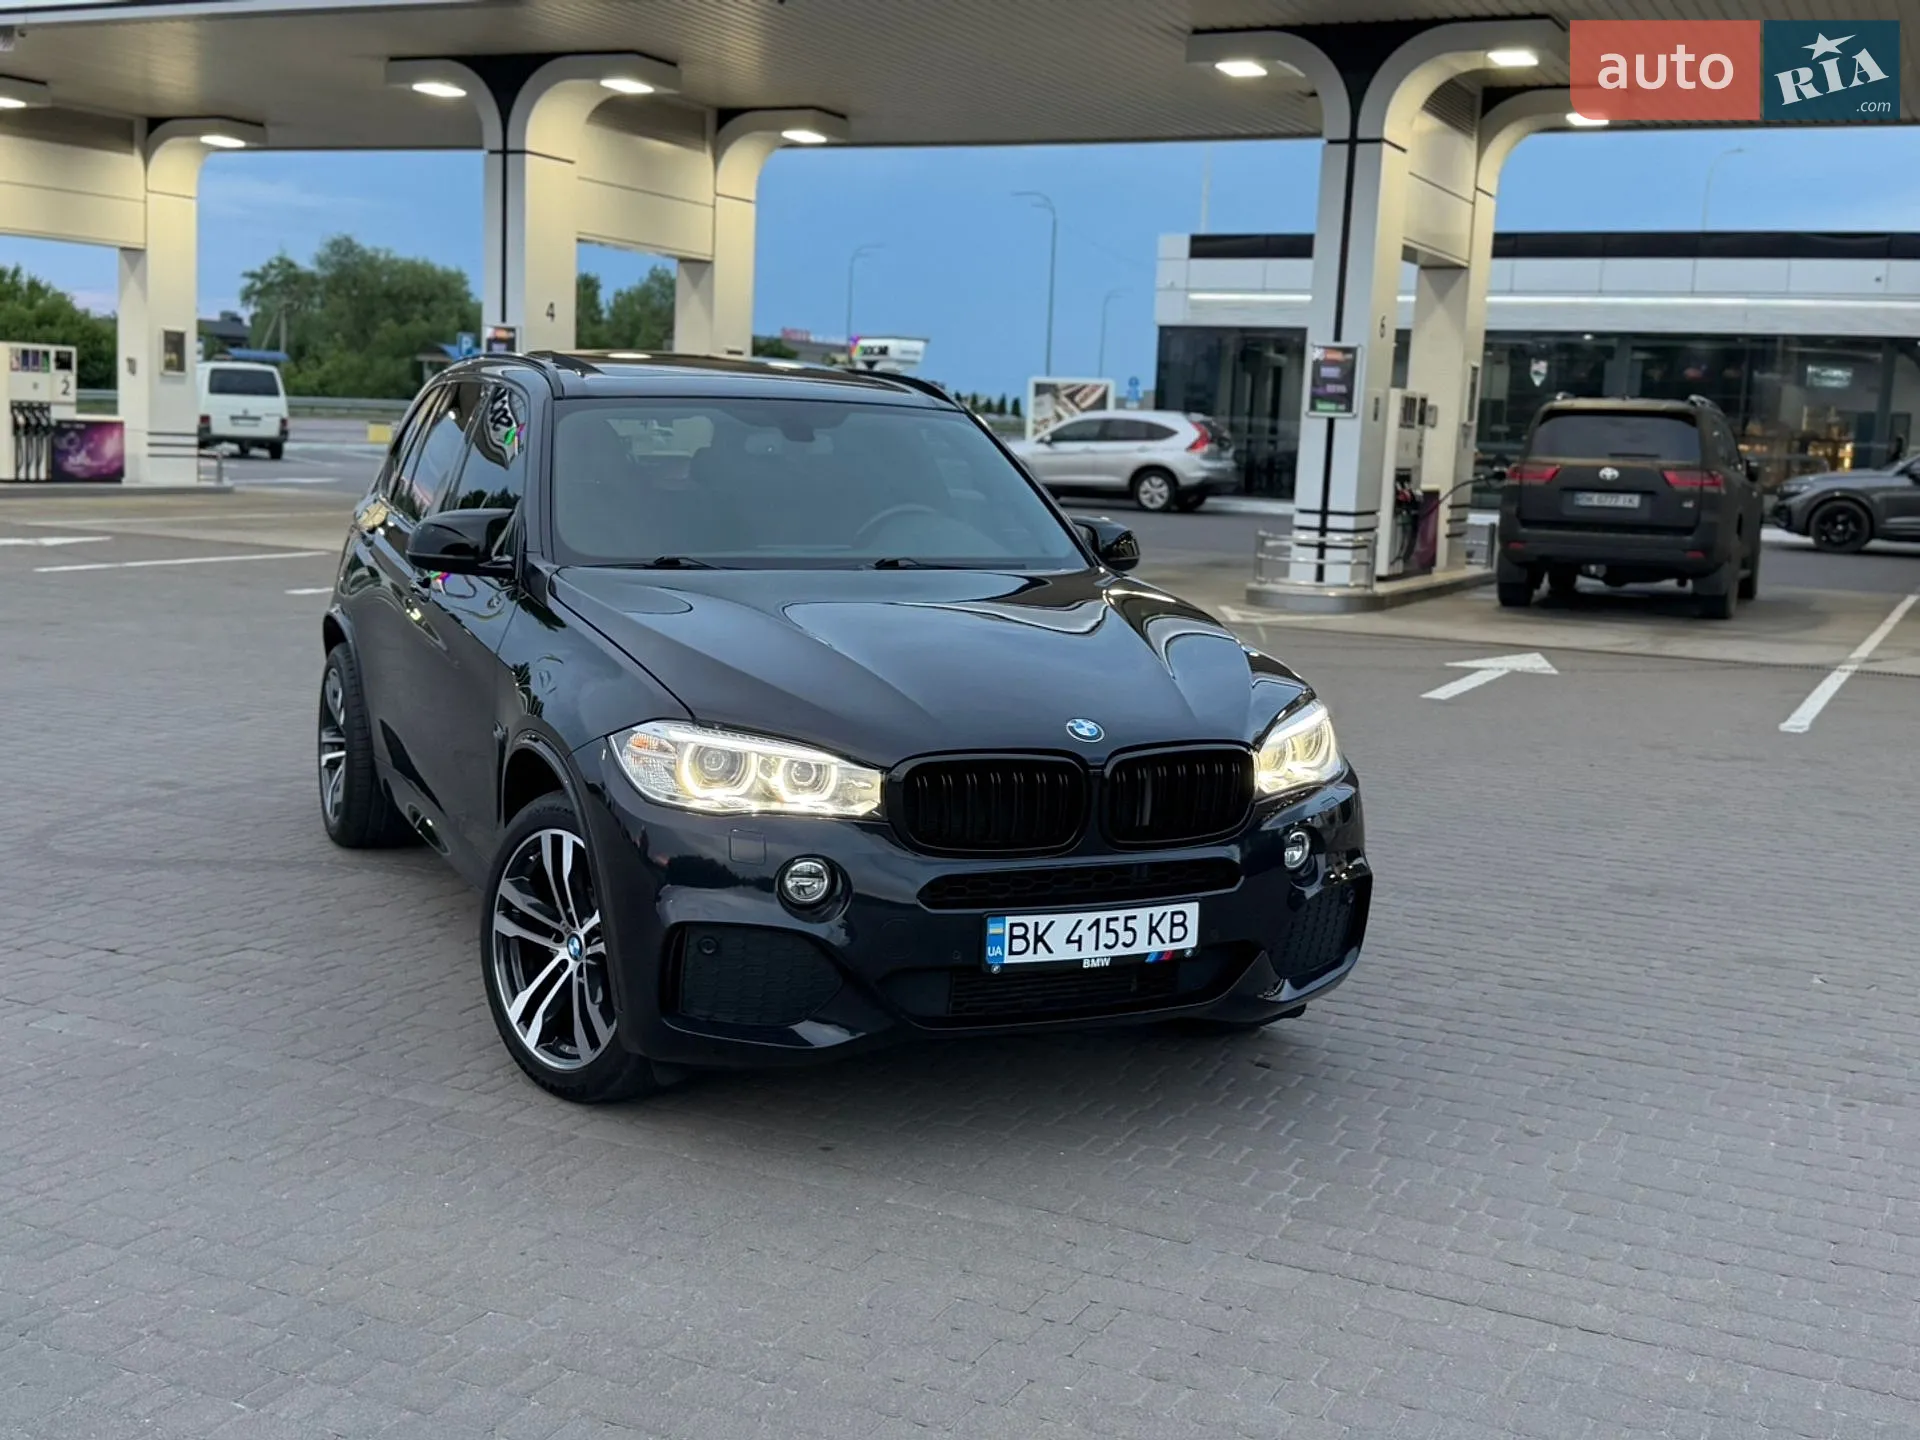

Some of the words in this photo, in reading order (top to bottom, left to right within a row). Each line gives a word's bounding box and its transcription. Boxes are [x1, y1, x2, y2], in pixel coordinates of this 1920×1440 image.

[545, 301, 555, 322] 4
[60, 379, 71, 396] 2
[1007, 920, 1056, 956] BK
[1065, 914, 1138, 952] 4155
[1147, 910, 1189, 947] KB
[987, 945, 1003, 957] UA
[1082, 957, 1111, 969] BMW
